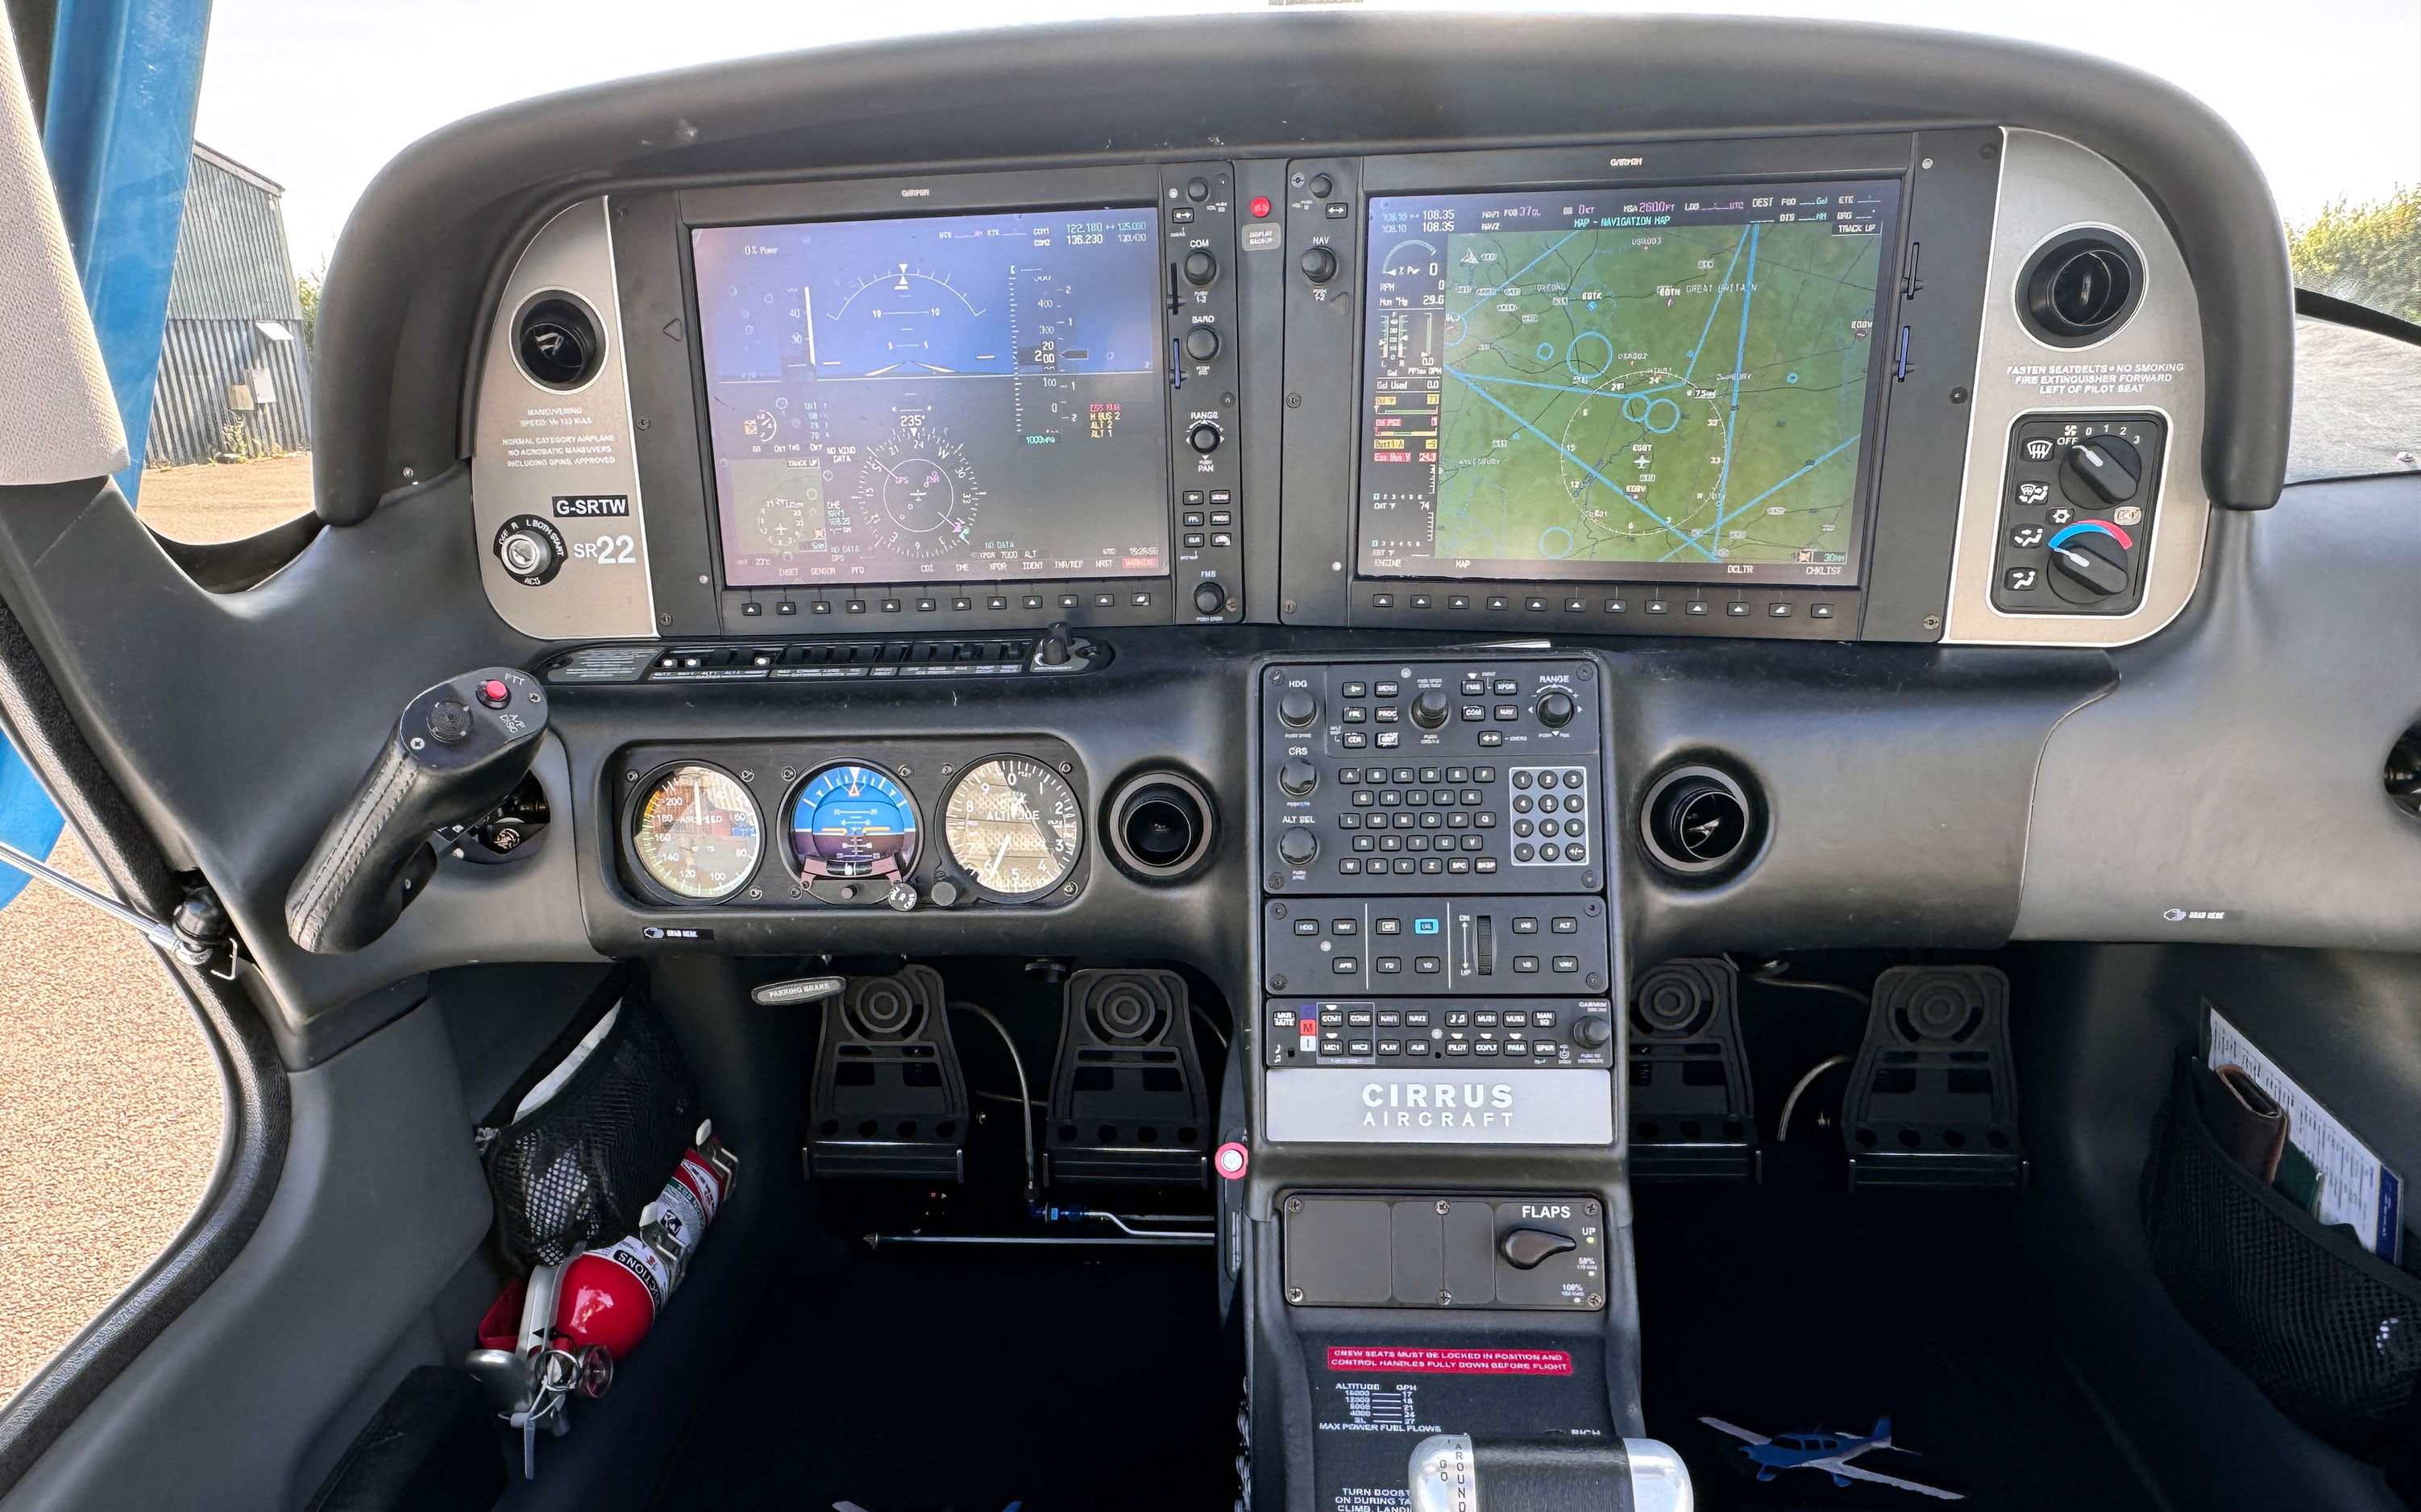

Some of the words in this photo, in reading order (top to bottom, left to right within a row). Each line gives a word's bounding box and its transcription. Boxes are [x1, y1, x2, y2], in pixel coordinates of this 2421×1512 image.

[1423, 210, 1455, 220] 108.35
[1601, 215, 1652, 226] NAVIGATION
[1422, 222, 1455, 232] 108.35
[1838, 225, 1861, 233] TRACK
[1864, 224, 1875, 232] UP
[1190, 239, 1209, 247] COM
[1313, 237, 1329, 245] NAV
[2007, 365, 2045, 374] FASTEN
[2049, 364, 2107, 374] SEATBELTS
[2116, 363, 2132, 372] NO
[2135, 363, 2184, 372] SMOKING
[2015, 376, 2038, 384] FIRE
[2041, 373, 2116, 384] EXTINGUISHER
[2120, 373, 2173, 382] FORWARD
[1391, 380, 1407, 389] Used
[2040, 384, 2066, 393] LEFT
[2067, 384, 2082, 393] OF
[2084, 384, 2116, 393] PILOT
[2118, 384, 2144, 393] SEAT
[2086, 427, 2092, 435] 0
[2104, 425, 2109, 433] 1
[2120, 426, 2127, 435] 2
[2057, 437, 2078, 445] OFF
[2133, 435, 2141, 443] 3
[575, 456, 615, 464] APPROVED
[556, 499, 625, 515] G-SRTW
[550, 534, 564, 557] START
[574, 534, 636, 564] SR22
[1539, 675, 1570, 683] RANGE
[1289, 747, 1308, 756] CRS
[1008, 773, 1016, 786] 0
[982, 783, 990, 795] 9
[1040, 782, 1043, 795] 1
[666, 797, 682, 805] 200
[966, 800, 974, 812] 8
[1055, 802, 1063, 815] 2
[734, 813, 745, 821] 60
[1055, 839, 1064, 851] 3
[736, 849, 747, 857] 80
[1038, 858, 1047, 871] 4
[680, 870, 696, 878] 120
[1011, 868, 1019, 880] 5
[769, 985, 803, 998] PARKING
[1302, 1022, 1313, 1033] M
[1381, 1044, 1397, 1052] PLAY
[1448, 1044, 1467, 1052] PILOT
[1362, 1083, 1514, 1109] CIRRUS
[1364, 1111, 1514, 1128] AIRCRAFT
[1522, 1205, 1571, 1219] FLAPS
[1582, 1227, 1596, 1236] UP
[1494, 1352, 1540, 1360] POSITION
[1427, 1360, 1456, 1369] FULLY
[1319, 1423, 1341, 1431] MAX
[1343, 1423, 1378, 1431] POWER
[1380, 1424, 1405, 1432] FUEL
[1455, 1443, 1466, 1512] AROUND
[1343, 1488, 1371, 1496] TURN
[1335, 1497, 1352, 1505] ON
[1355, 1497, 1395, 1506] DURING
